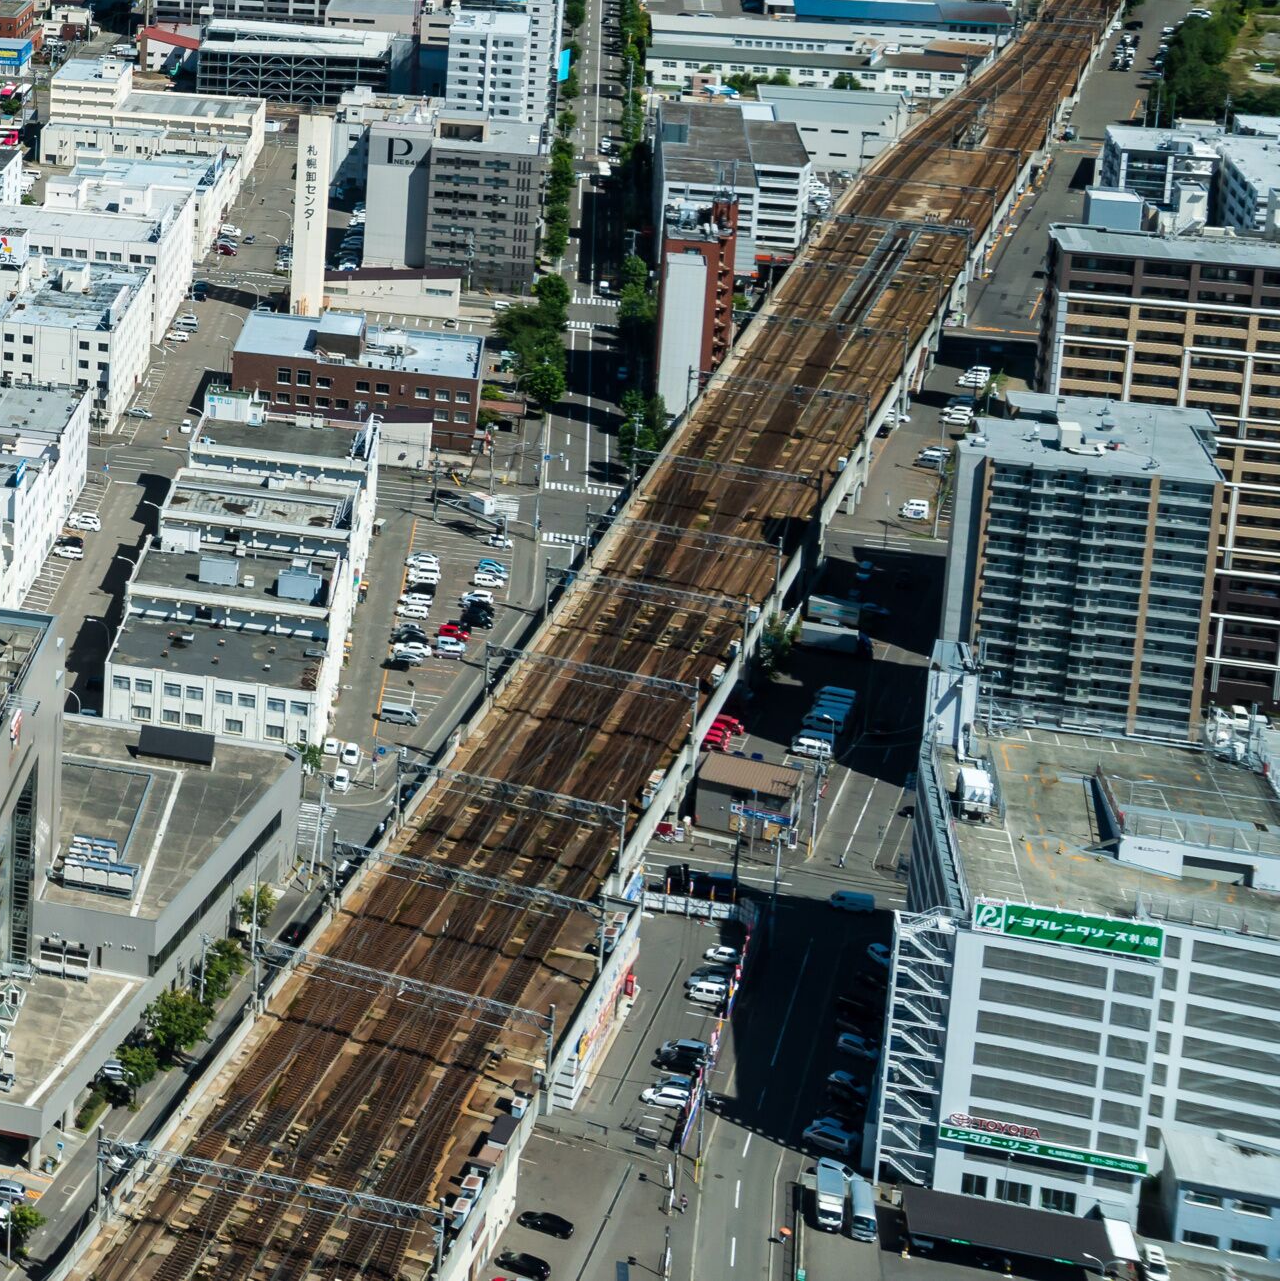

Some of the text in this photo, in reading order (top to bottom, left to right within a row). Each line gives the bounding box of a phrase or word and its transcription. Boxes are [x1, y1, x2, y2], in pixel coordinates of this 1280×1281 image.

[303, 144, 318, 231] 札幌卸センター
[1007, 914, 1160, 948] トヨタレンタリース札幌
[946, 1129, 1040, 1154] レンタカー・リース
[977, 1118, 1041, 1139] TOYOTA
